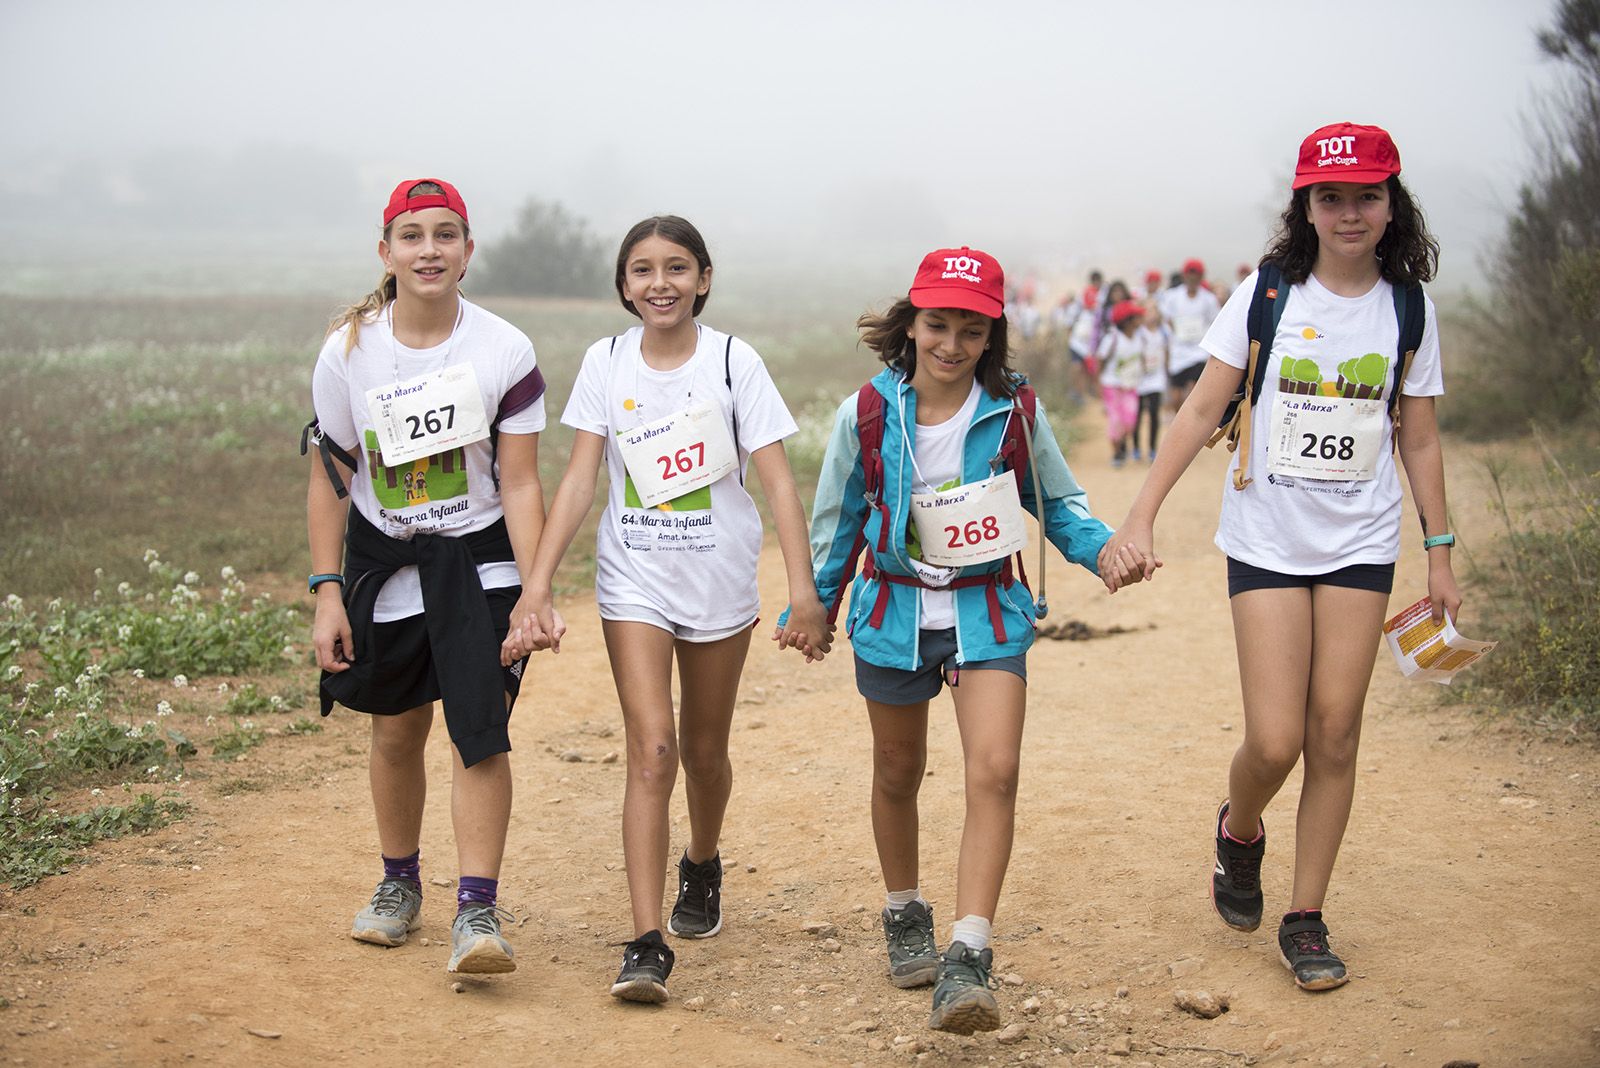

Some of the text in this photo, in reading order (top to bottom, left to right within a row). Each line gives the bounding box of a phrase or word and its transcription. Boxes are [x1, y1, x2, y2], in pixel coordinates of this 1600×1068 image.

[1316, 135, 1356, 158] TOT
[943, 256, 982, 275] TOT
[405, 403, 455, 440] 267
[1300, 432, 1355, 461] 268
[656, 441, 704, 480] 267
[428, 499, 470, 521] Infantil
[639, 515, 672, 527] Marxa
[673, 514, 712, 530] Infantil
[944, 515, 1000, 549] 268
